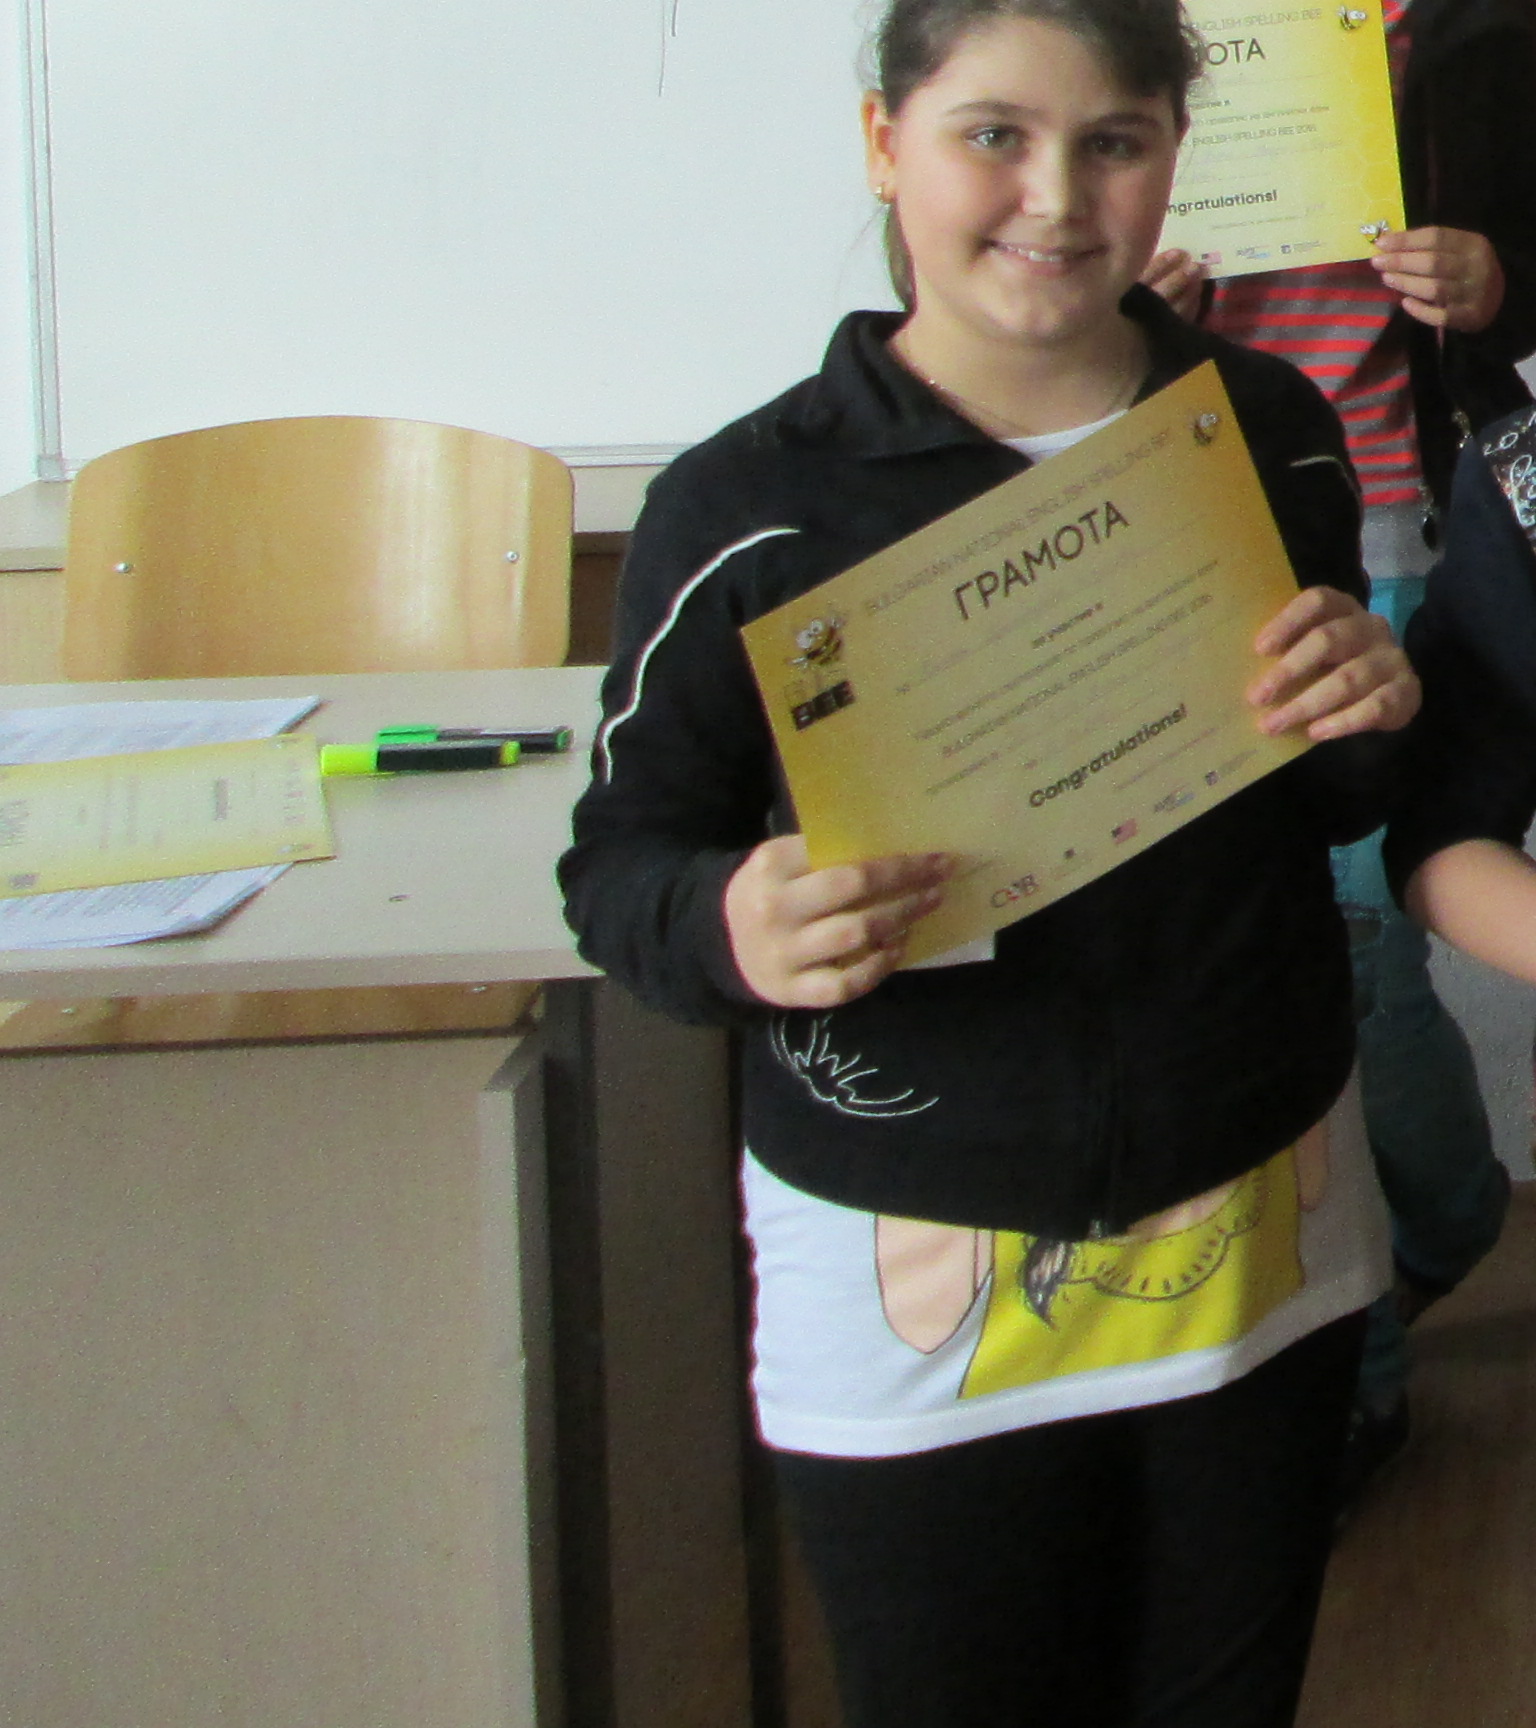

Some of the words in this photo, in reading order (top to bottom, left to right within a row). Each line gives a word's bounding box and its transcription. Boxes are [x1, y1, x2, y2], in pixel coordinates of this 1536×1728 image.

[1167, 189, 1278, 217] ngratulations!
[952, 500, 1131, 620] ГРАМОТА
[1028, 702, 1189, 809] Congratulations!
